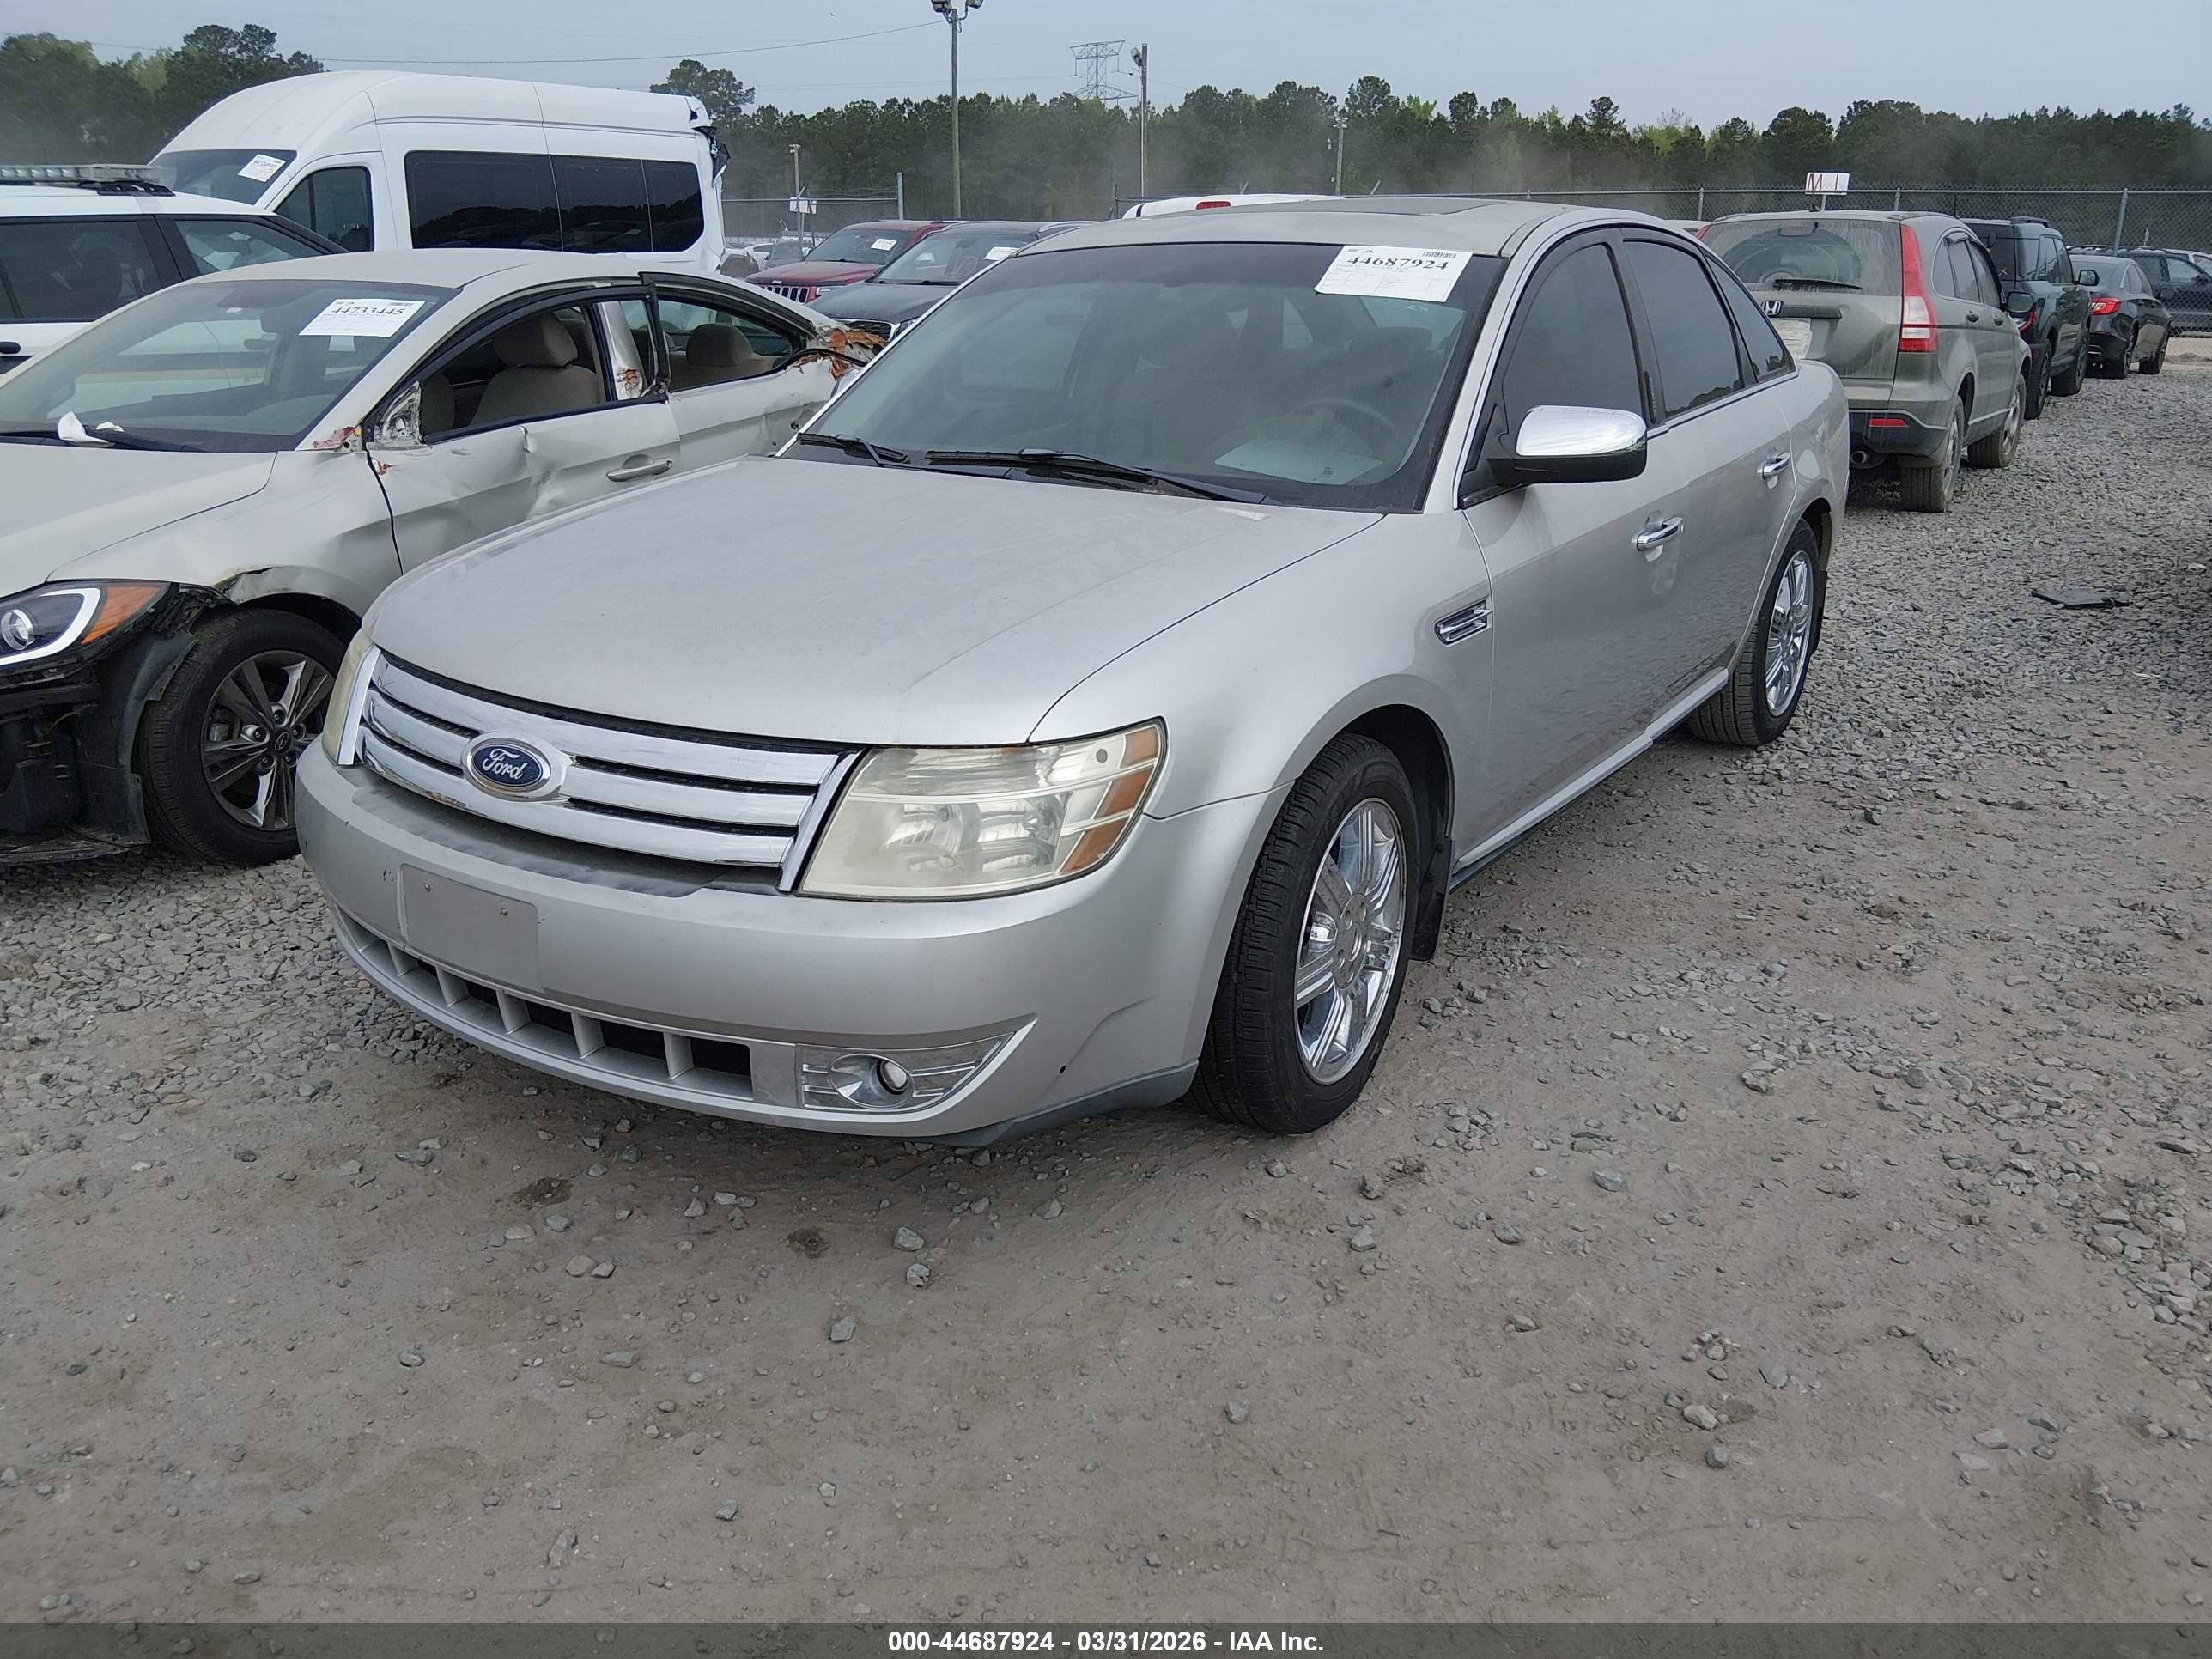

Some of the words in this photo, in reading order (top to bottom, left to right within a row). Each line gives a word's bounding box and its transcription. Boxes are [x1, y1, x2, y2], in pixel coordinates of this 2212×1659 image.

[1807, 173, 1823, 192] M
[1346, 256, 1449, 270] 44687924
[331, 307, 406, 315] 44733445
[482, 748, 529, 780] Ford
